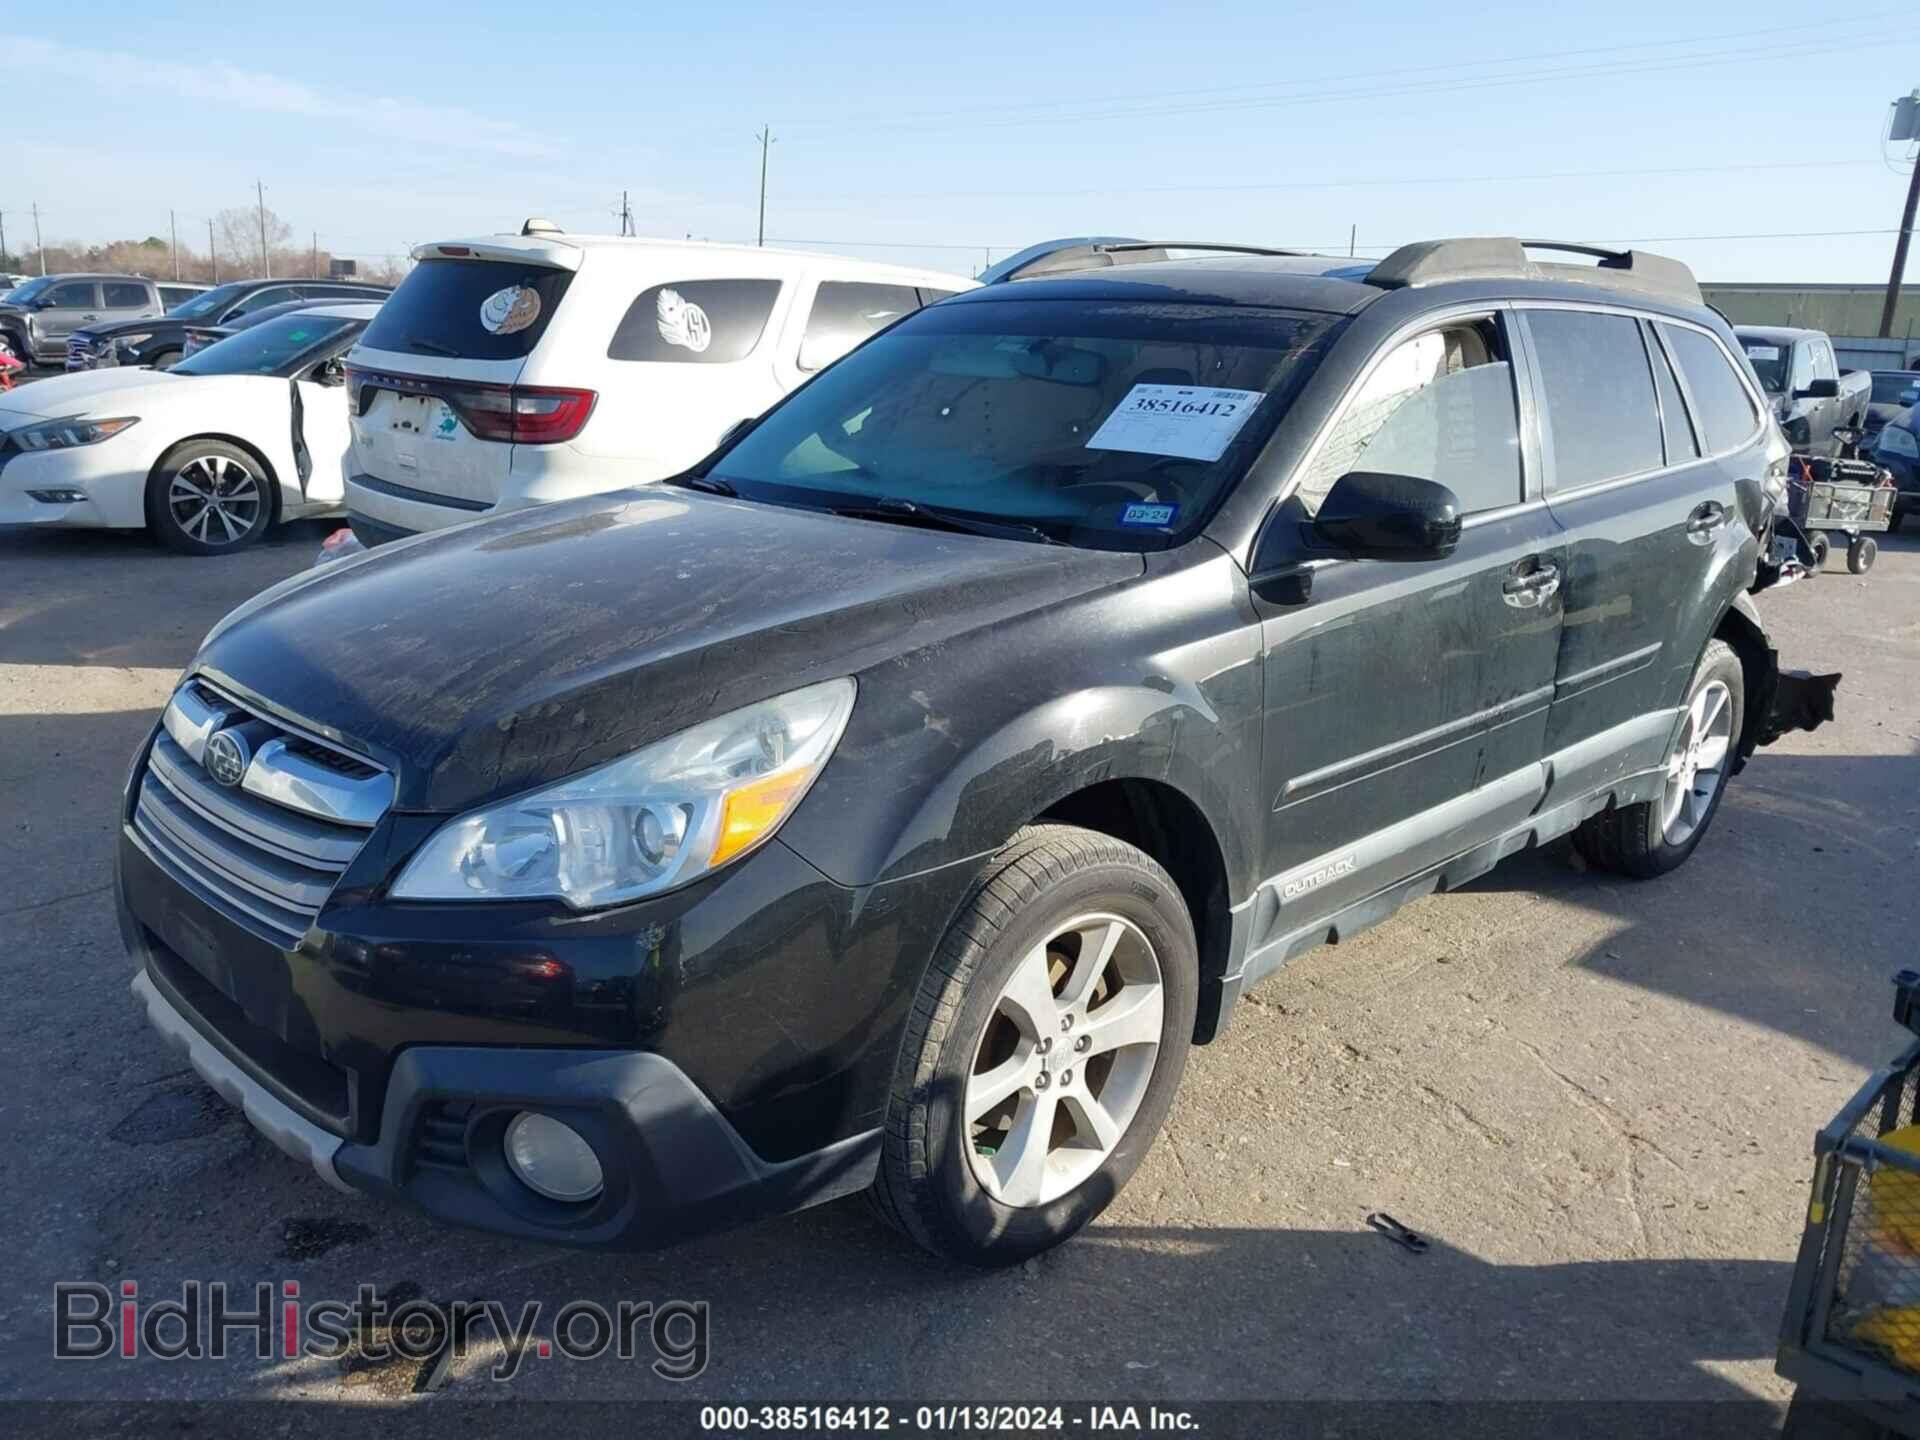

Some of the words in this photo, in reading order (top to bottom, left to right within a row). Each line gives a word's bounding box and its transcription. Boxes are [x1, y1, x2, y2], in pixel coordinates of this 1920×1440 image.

[1130, 398, 1236, 417] 38516412
[1128, 509, 1170, 520] 03-24
[1284, 855, 1355, 897] OUTBACK
